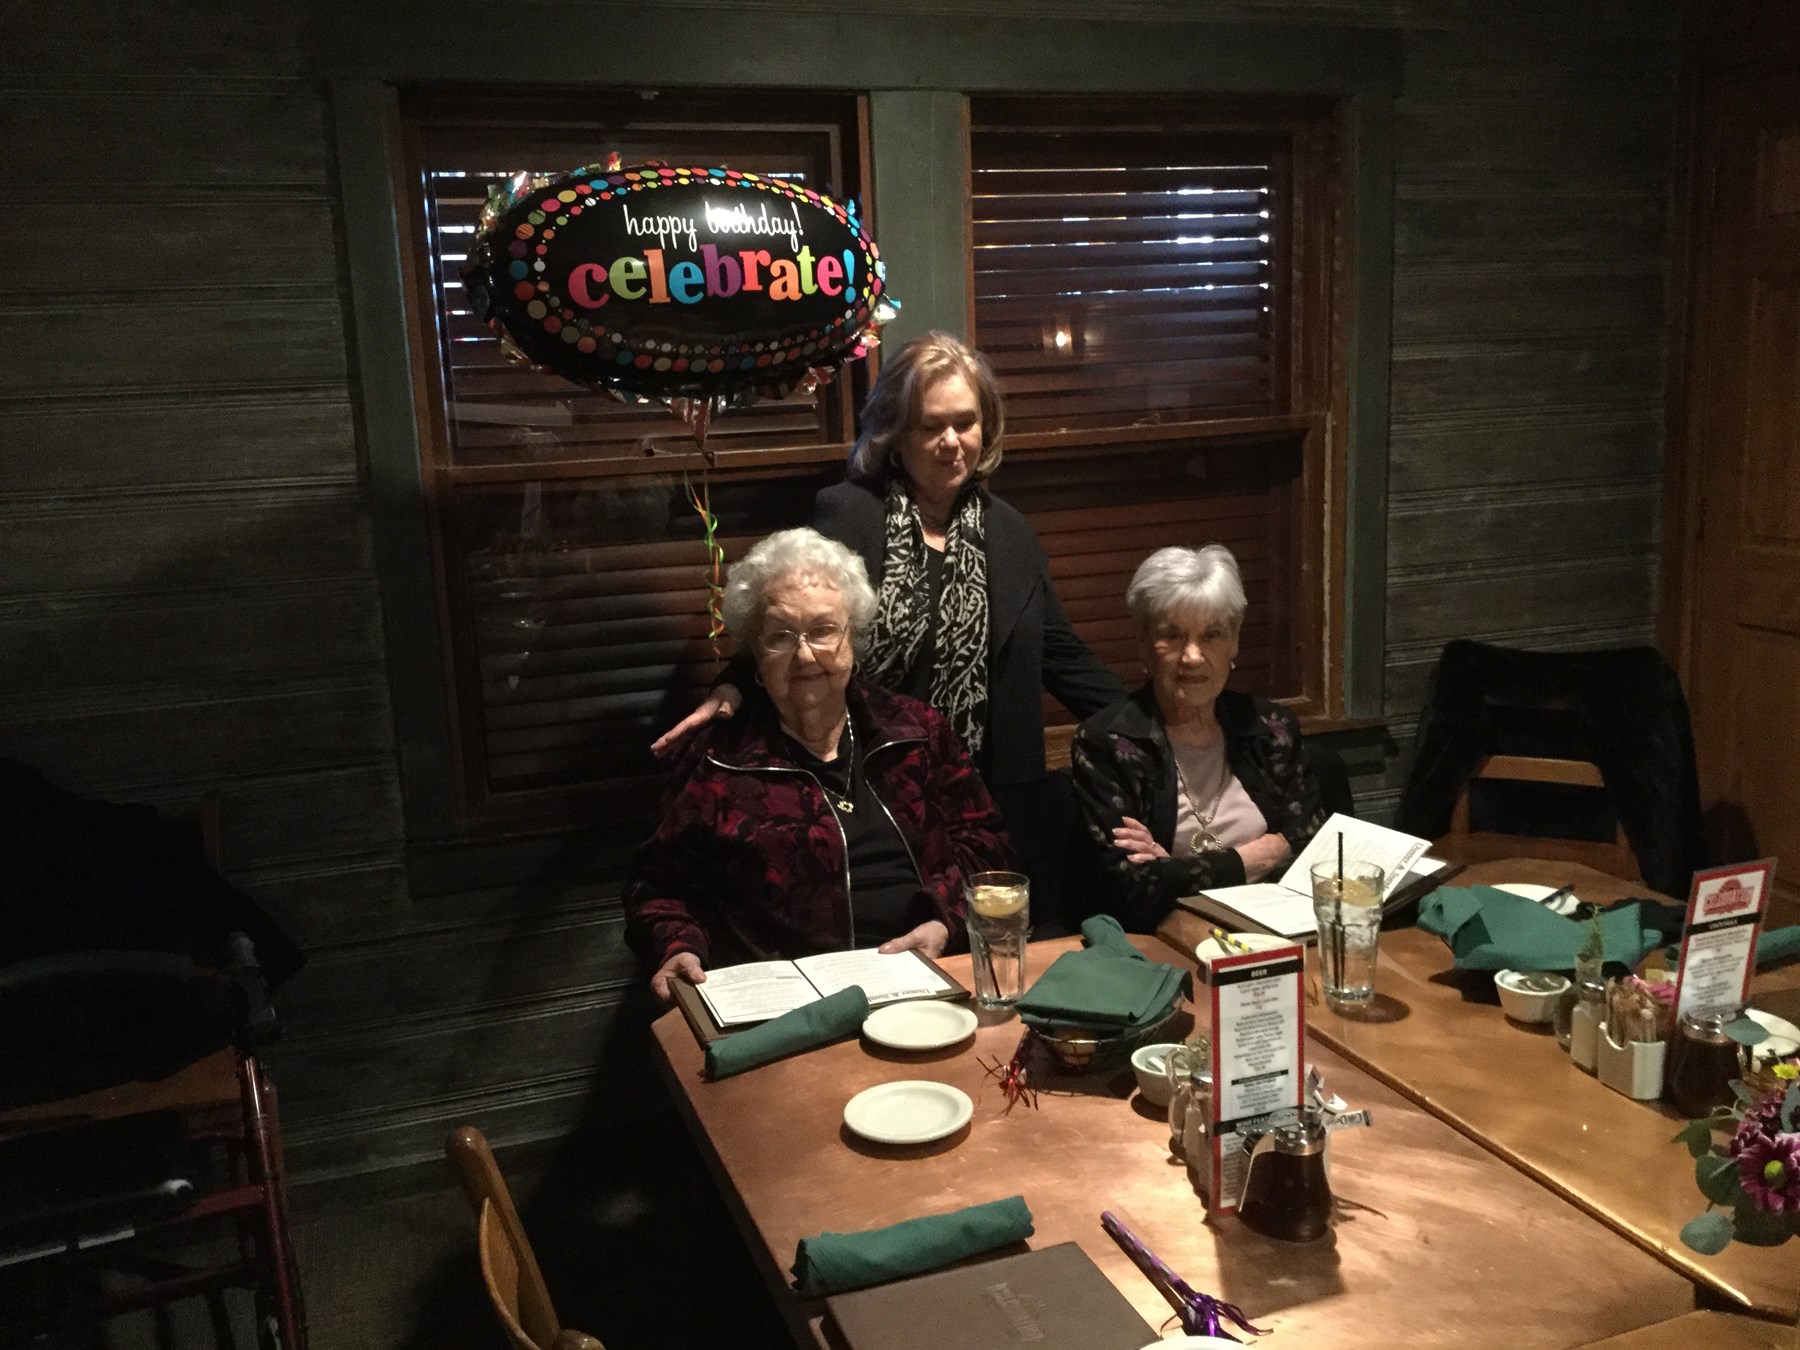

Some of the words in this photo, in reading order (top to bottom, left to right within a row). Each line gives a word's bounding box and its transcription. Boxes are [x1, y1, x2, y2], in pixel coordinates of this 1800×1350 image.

[623, 203, 698, 252] happy
[704, 201, 804, 253] bthday!
[568, 244, 858, 309] celebrate!
